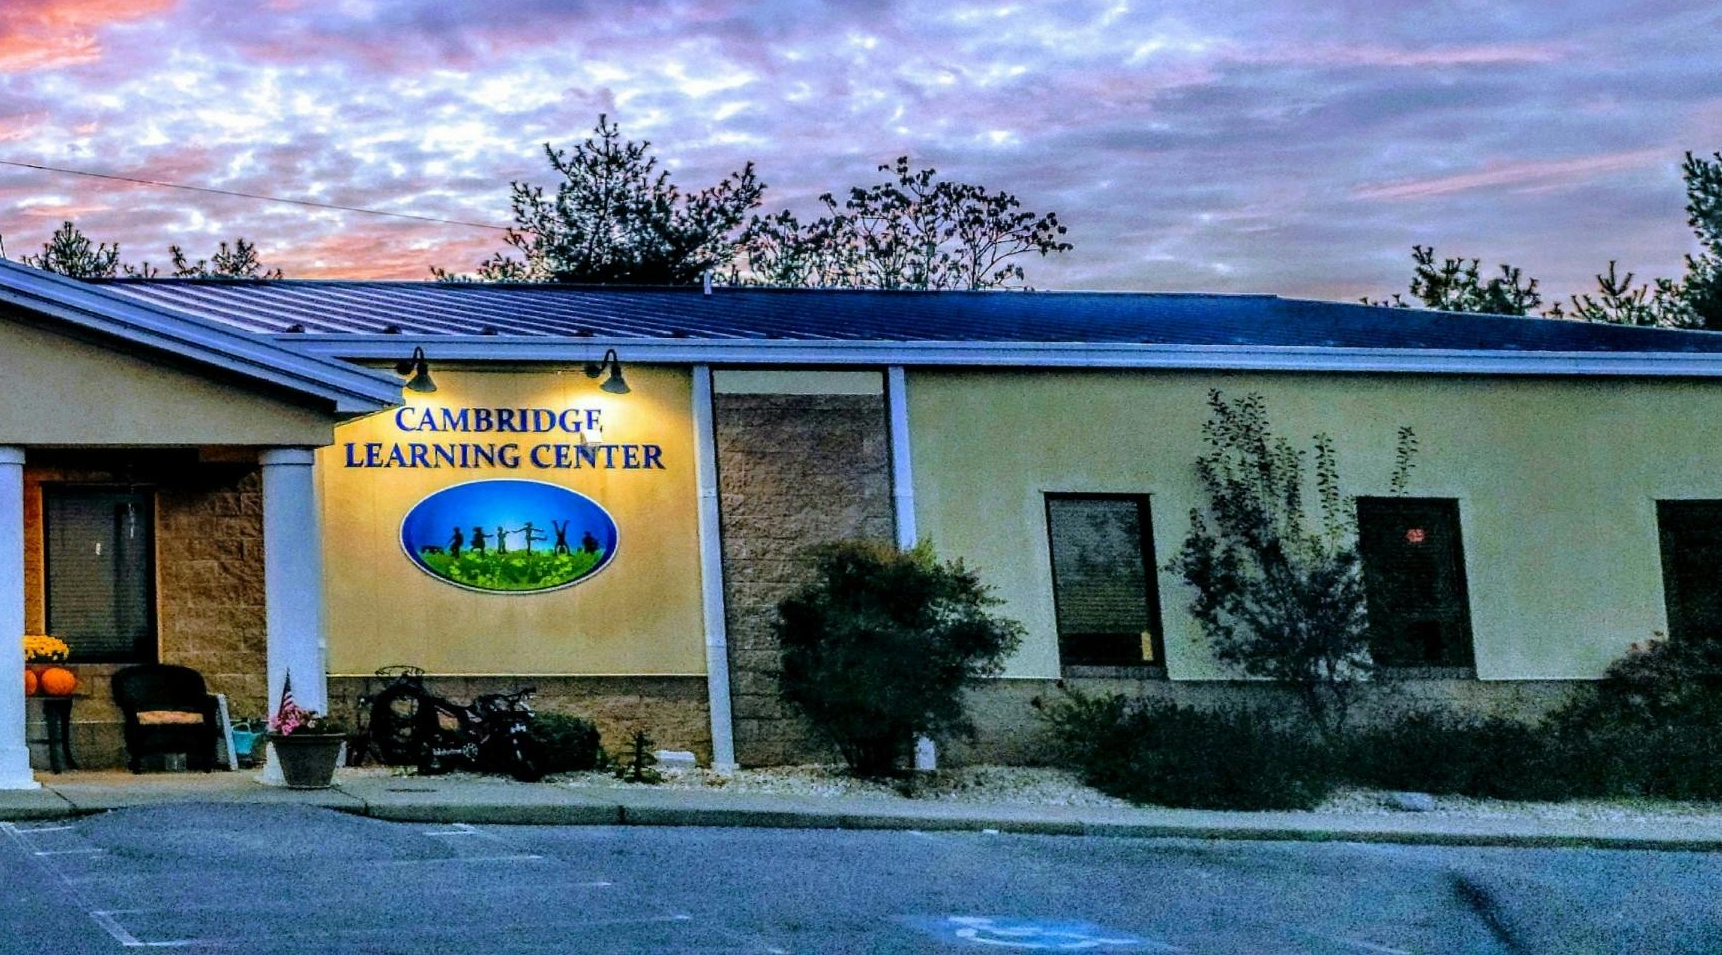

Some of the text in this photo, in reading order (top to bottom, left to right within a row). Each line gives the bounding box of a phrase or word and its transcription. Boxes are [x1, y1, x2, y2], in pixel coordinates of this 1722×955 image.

[395, 406, 603, 433] CAMBRIDGE
[344, 442, 665, 470] LEARNING CENTER
